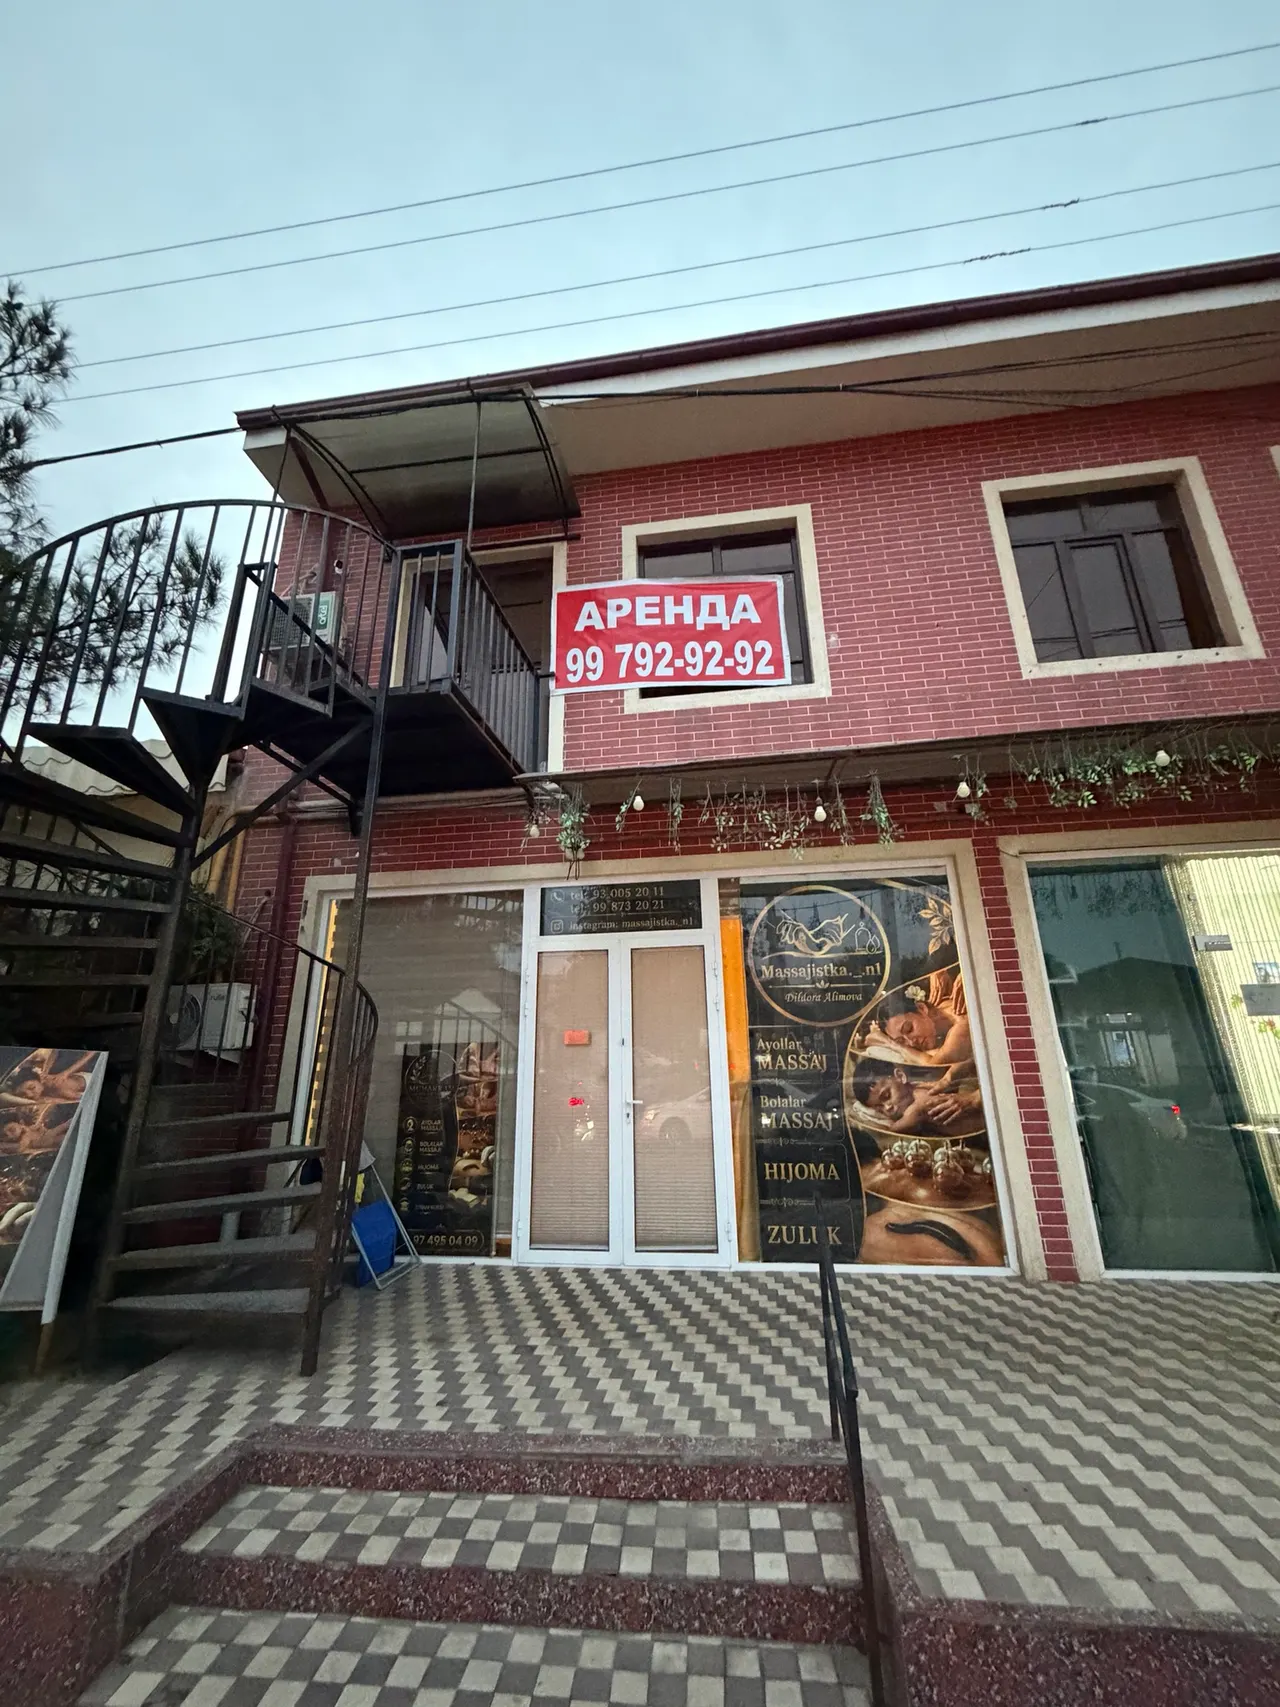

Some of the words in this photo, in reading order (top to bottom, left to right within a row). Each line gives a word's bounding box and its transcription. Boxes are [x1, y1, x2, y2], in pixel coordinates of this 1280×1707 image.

[574, 594, 762, 632] АРЕНДА
[565, 645, 604, 684] 99
[615, 640, 775, 678] 792-92-92
[593, 889, 607, 899] 93
[610, 888, 632, 898] 005
[635, 887, 649, 897] 20
[653, 886, 664, 896] 11
[593, 902, 607, 913] 99
[611, 901, 632, 911] 873
[635, 900, 649, 910] 20
[653, 899, 664, 909] 21
[570, 919, 618, 931] instagram:
[785, 992, 822, 1003] Dildora
[823, 991, 862, 1002] Alimova
[756, 1037, 802, 1052] Ayollar
[757, 1054, 828, 1073] MASSAJ
[760, 1095, 807, 1108] Bolalar
[760, 1112, 833, 1132] MASSAJ
[764, 1162, 841, 1183] HIJOMA
[413, 1235, 425, 1245] 97
[427, 1235, 446, 1246] 495
[449, 1235, 462, 1246] 04
[465, 1235, 478, 1247] 09
